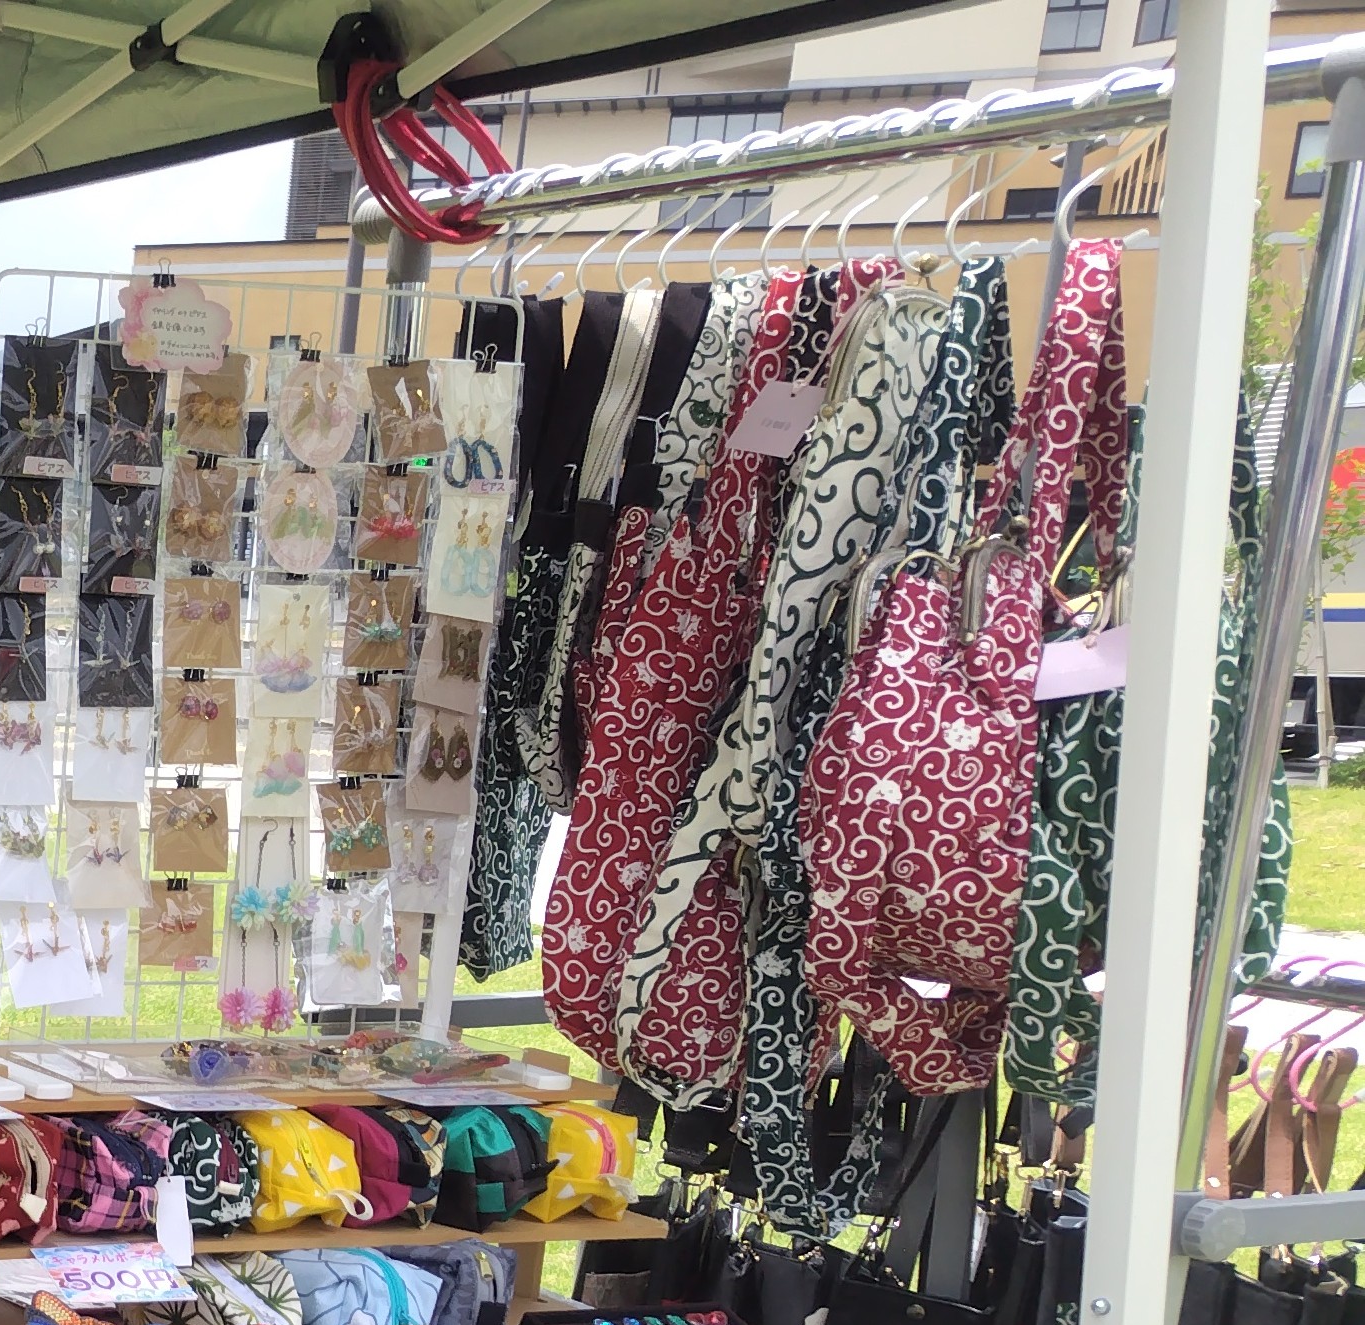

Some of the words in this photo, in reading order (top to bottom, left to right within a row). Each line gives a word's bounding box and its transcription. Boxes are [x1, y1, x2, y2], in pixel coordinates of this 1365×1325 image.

[37, 462, 64, 474] ピアス
[126, 470, 150, 480] ピアス
[481, 481, 505, 491] ピアス
[34, 579, 58, 589] ピアス
[125, 580, 149, 590] ピアス
[64, 1269, 178, 1291] 500円
